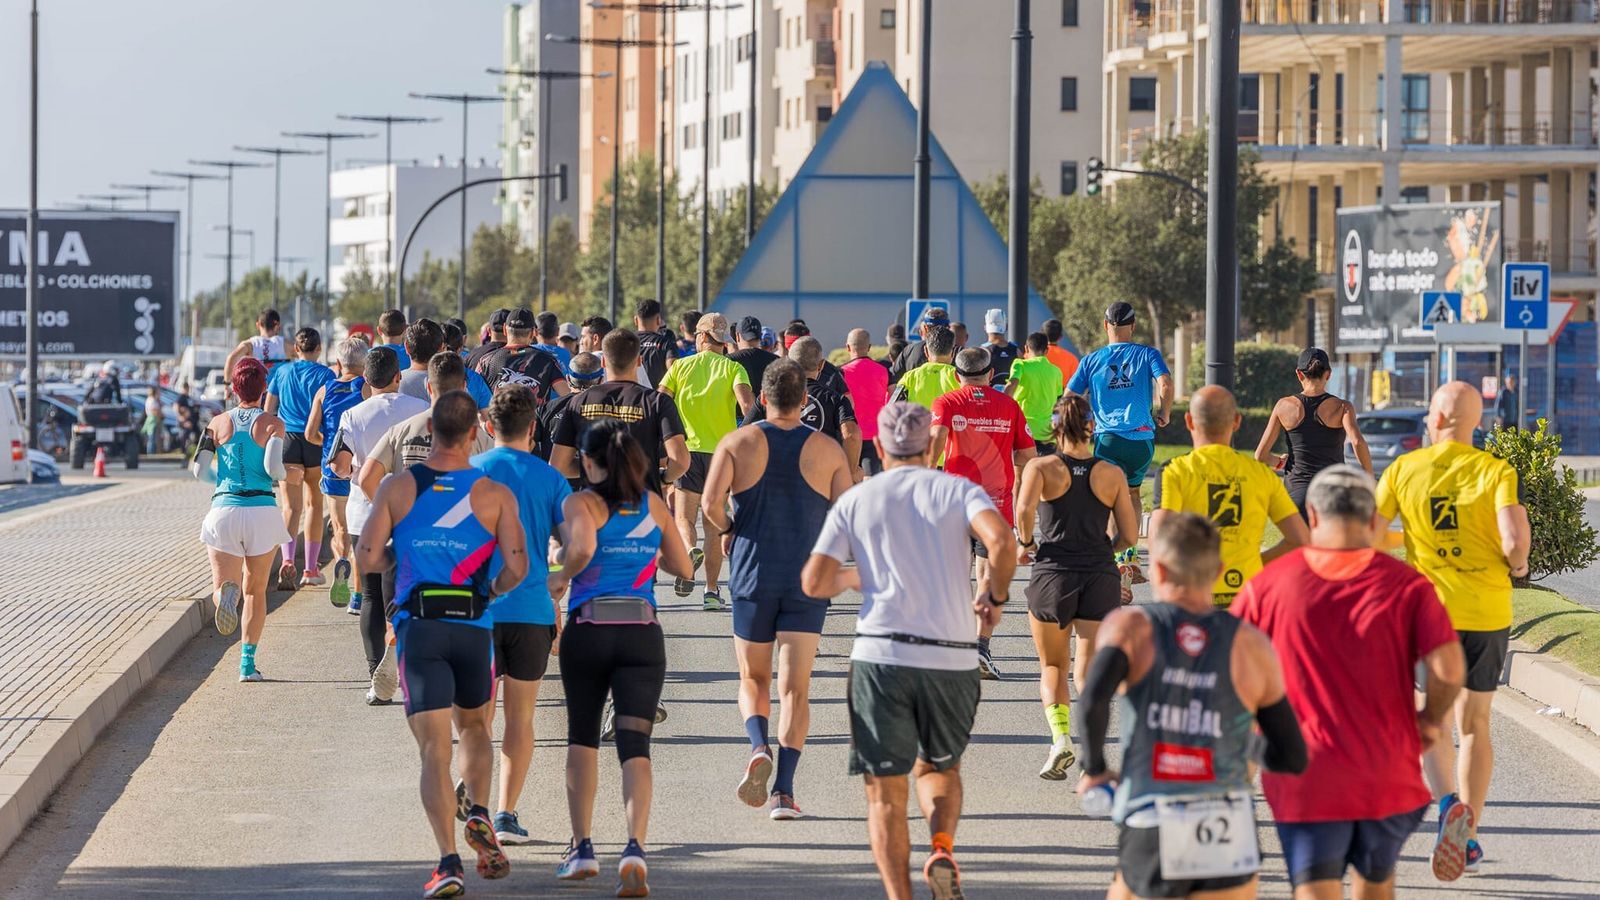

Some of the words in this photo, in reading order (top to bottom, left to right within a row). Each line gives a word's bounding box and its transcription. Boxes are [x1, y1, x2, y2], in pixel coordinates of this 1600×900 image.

[0, 231, 91, 266] MA
[1406, 247, 1438, 267] todo
[57, 275, 152, 289] COLCHONES
[1396, 270, 1435, 294] mejor
[412, 539, 447, 547] Carmona
[1147, 699, 1223, 738] CANIBAL
[1196, 816, 1231, 845] 62
